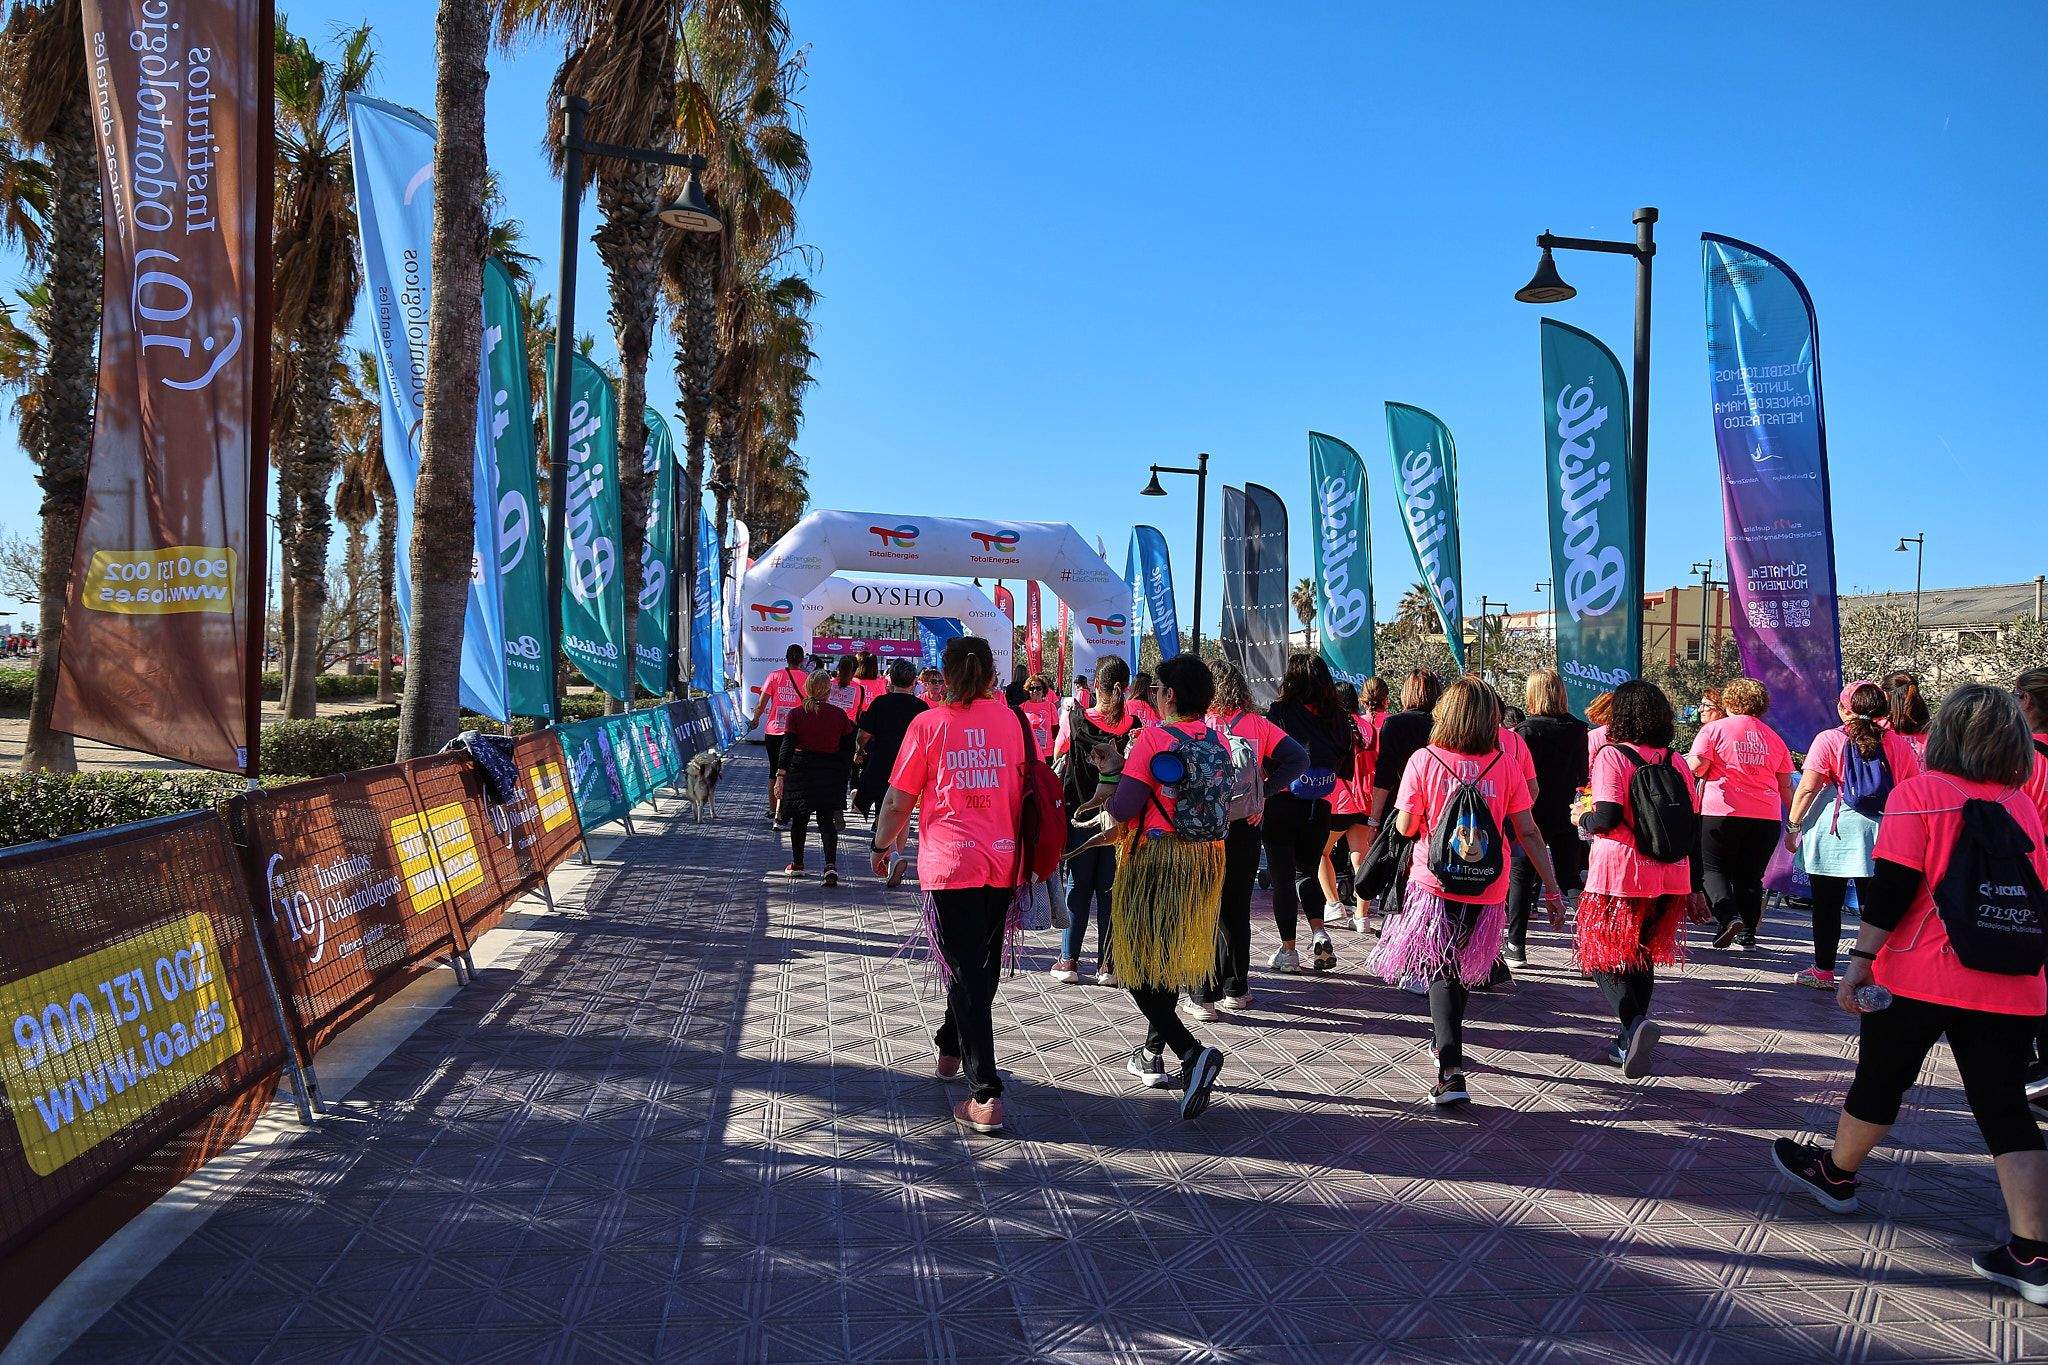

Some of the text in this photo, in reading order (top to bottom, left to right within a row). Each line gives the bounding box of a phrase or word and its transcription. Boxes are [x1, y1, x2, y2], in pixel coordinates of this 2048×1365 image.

[868, 550, 919, 560] TotalEnergies
[970, 555, 1020, 565] TotalEnergies
[851, 585, 944, 607] OYSHO
[801, 604, 824, 612] YSHO
[968, 610, 997, 618] OYSHO
[750, 625, 794, 634] TotalEnergies
[964, 728, 986, 748] TU
[946, 748, 1006, 770] DORSAL
[1738, 753, 1765, 766] SUMA
[955, 769, 1000, 790] SUMA
[1300, 773, 1336, 786] OYSHO
[965, 795, 992, 809] 2025
[956, 840, 976, 849] SHO
[314, 852, 372, 890] Institutos
[325, 873, 402, 923] Odontológicos
[13, 941, 214, 1070] 900 131 002
[34, 1000, 226, 1133] www.ioa.es
